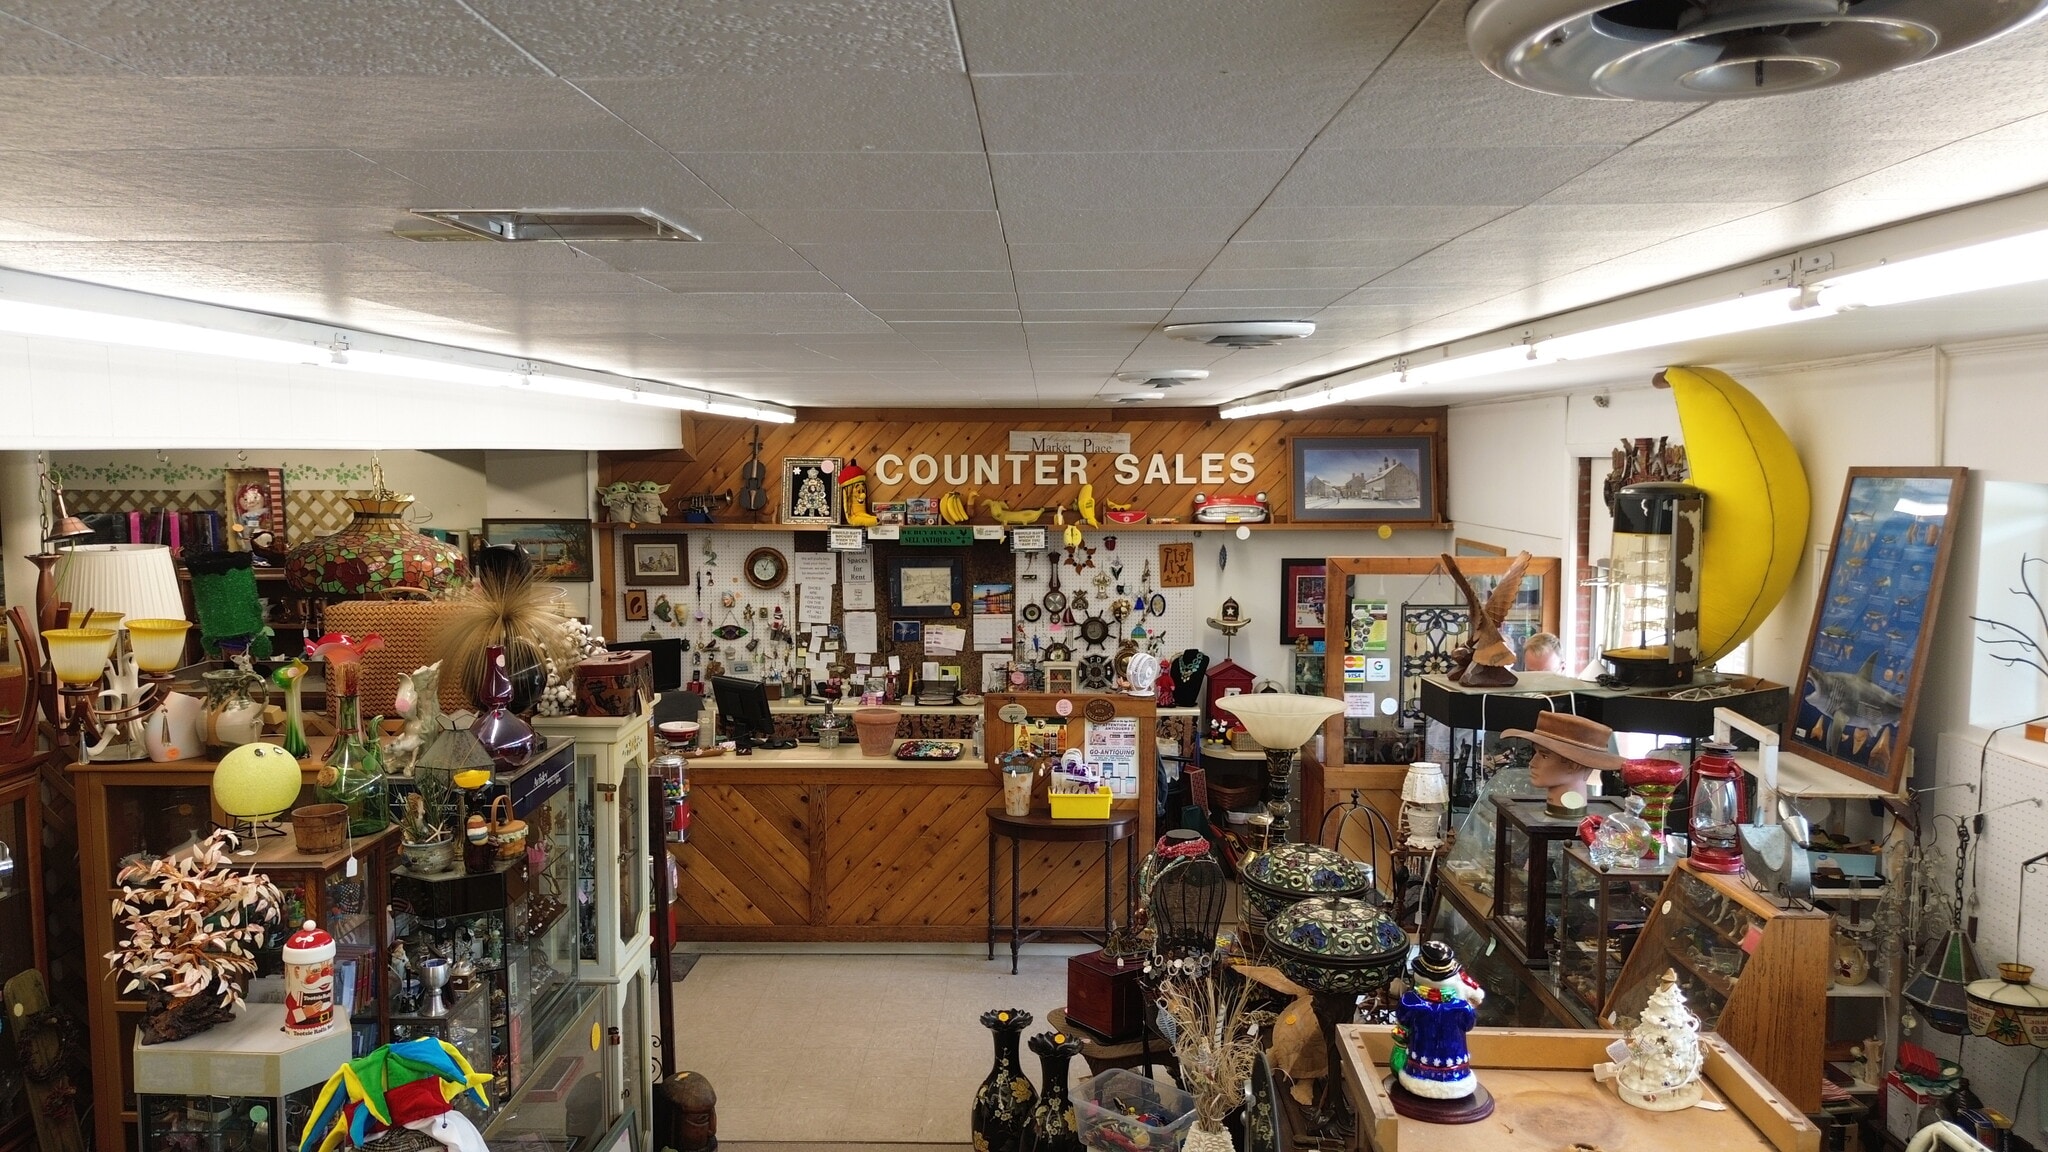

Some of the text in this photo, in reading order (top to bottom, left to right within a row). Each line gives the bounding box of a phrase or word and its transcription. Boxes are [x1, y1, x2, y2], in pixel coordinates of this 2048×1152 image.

[1031, 438, 1072, 452] Market
[1083, 438, 1112, 453] Place
[875, 452, 1256, 485] COUNTER SALES
[904, 536, 952, 544] SELL ANTIQUES
